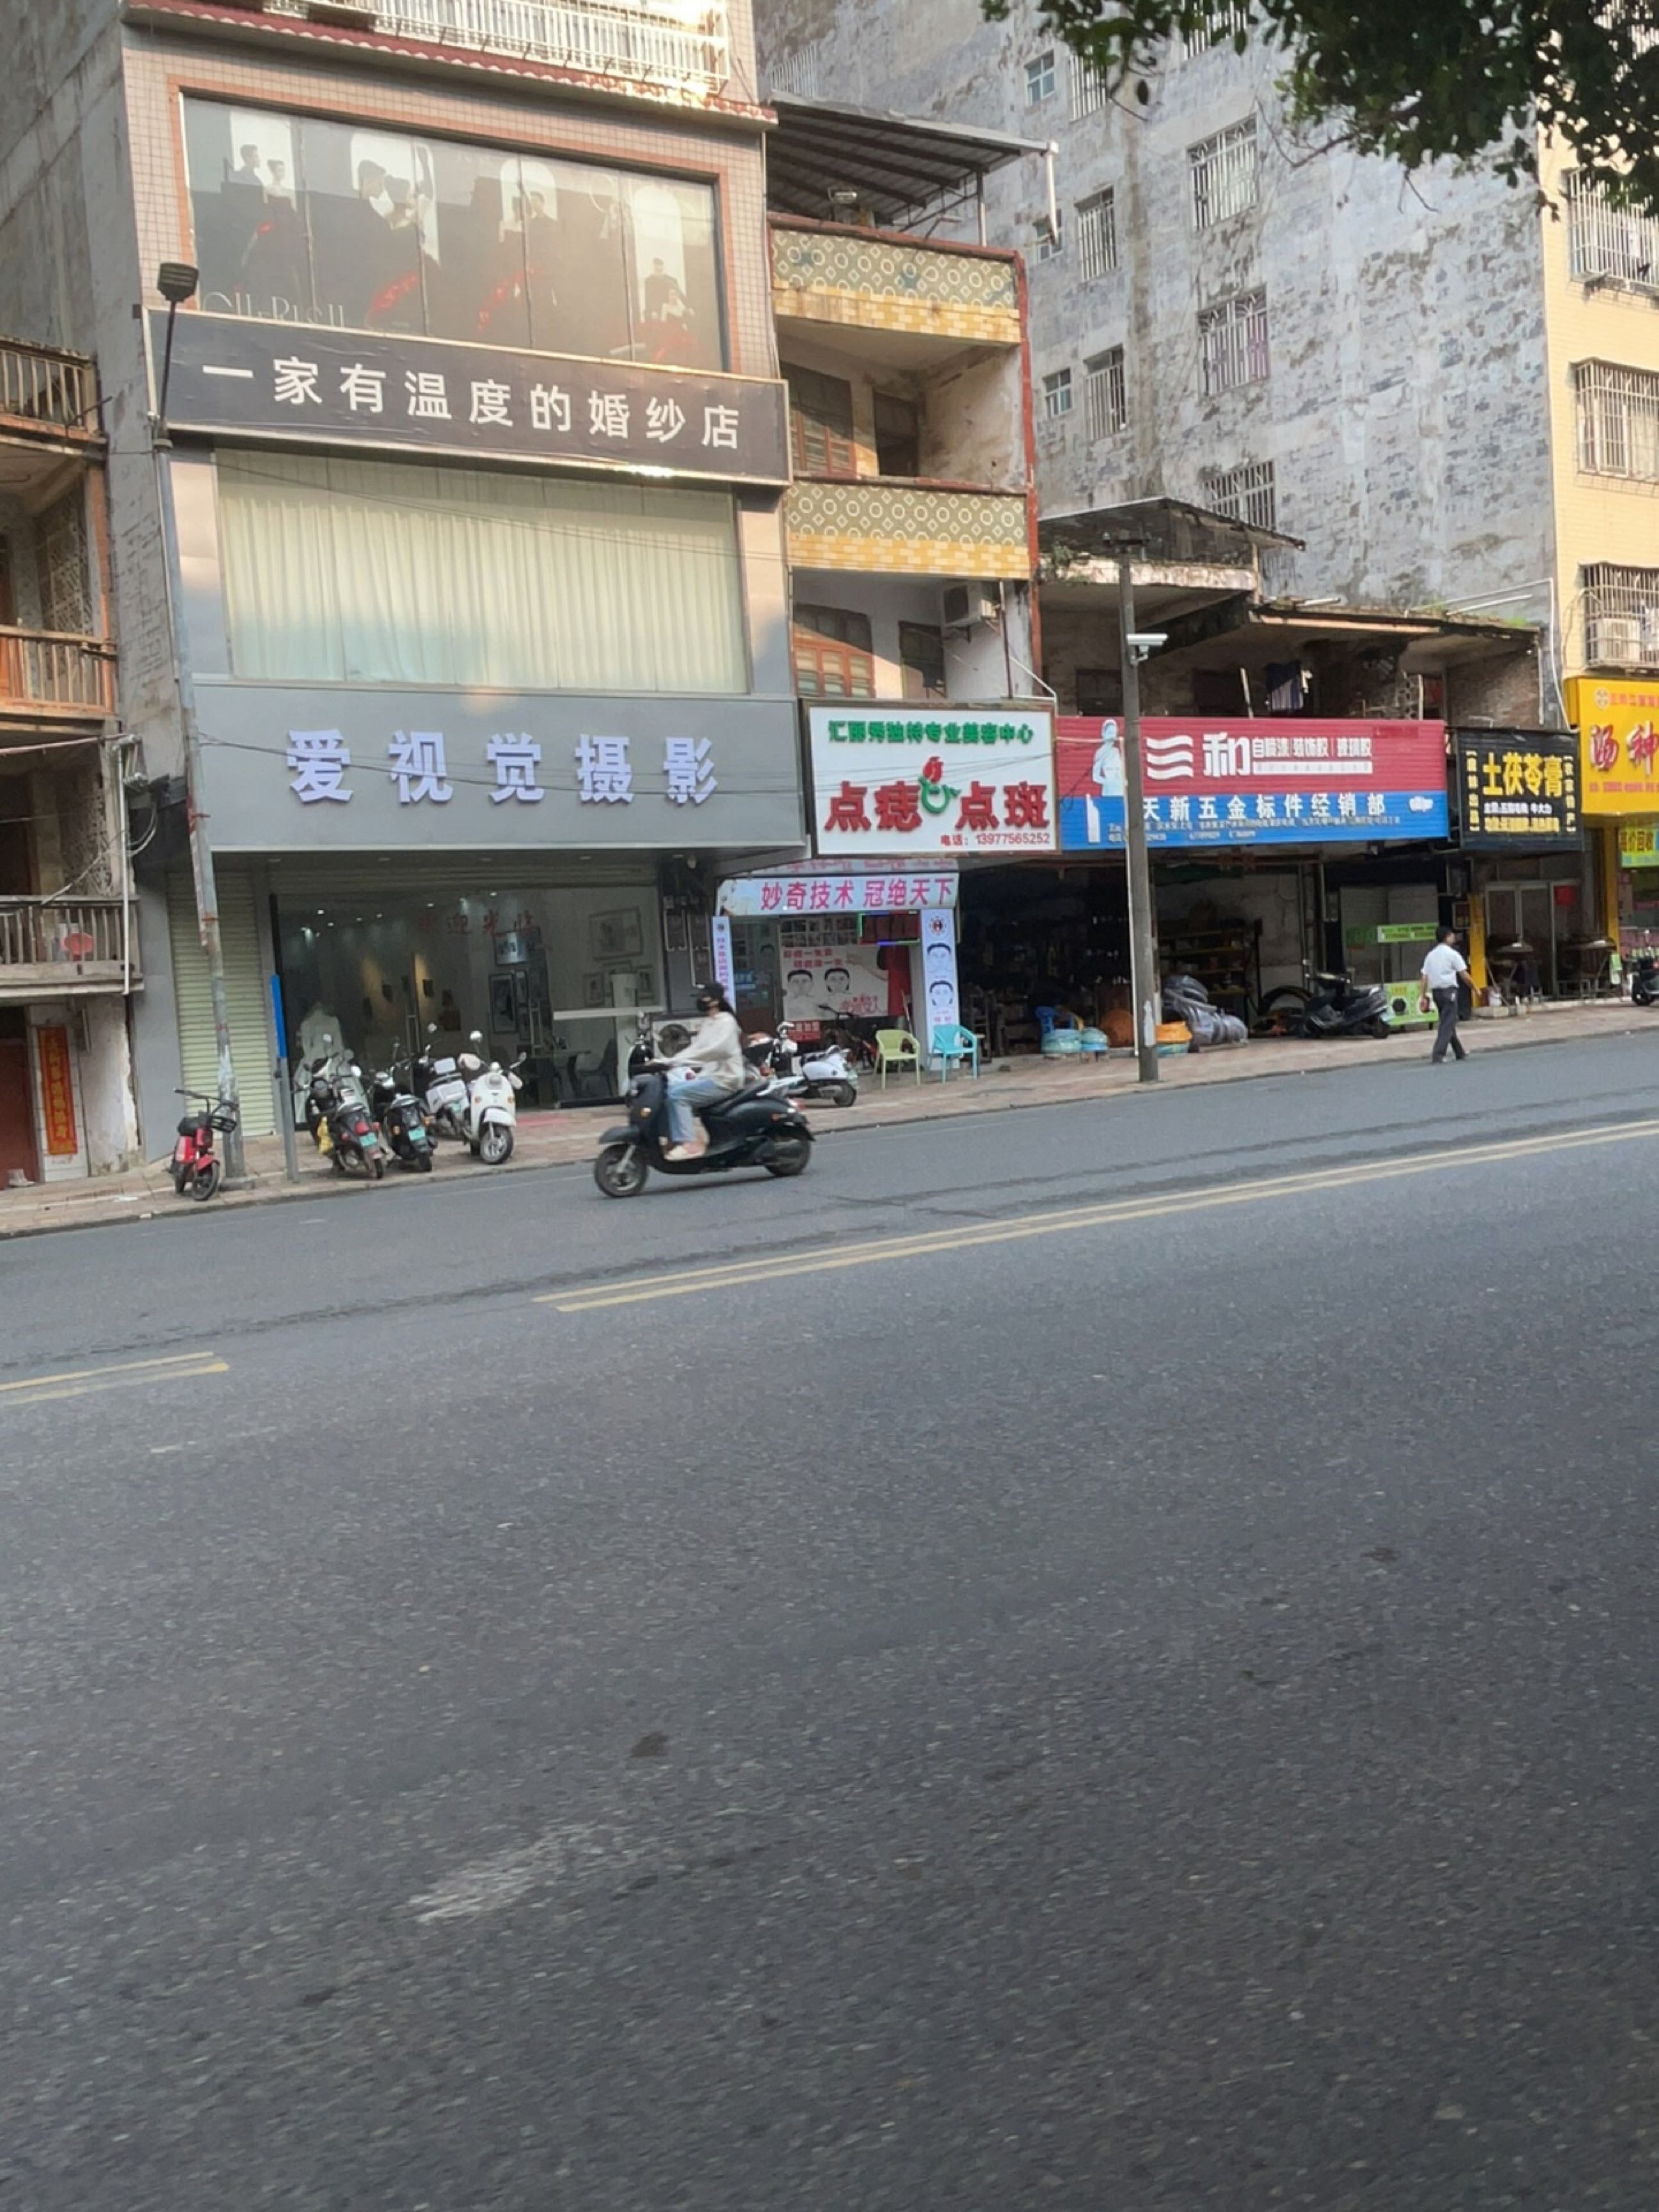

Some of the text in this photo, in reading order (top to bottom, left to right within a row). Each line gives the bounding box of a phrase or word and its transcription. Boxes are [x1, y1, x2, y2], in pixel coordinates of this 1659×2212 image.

[202, 357, 740, 449] 一家有温度的婚纱店
[286, 728, 719, 805] 爱视觉摄影
[1146, 732, 1250, 779] 三和
[1482, 752, 1563, 797] 土茯苓膏
[825, 781, 1049, 831] 点痣 点斑
[976, 834, 1050, 846] 13977565252
[761, 877, 954, 910] 妙奇技术 冠绝天下
